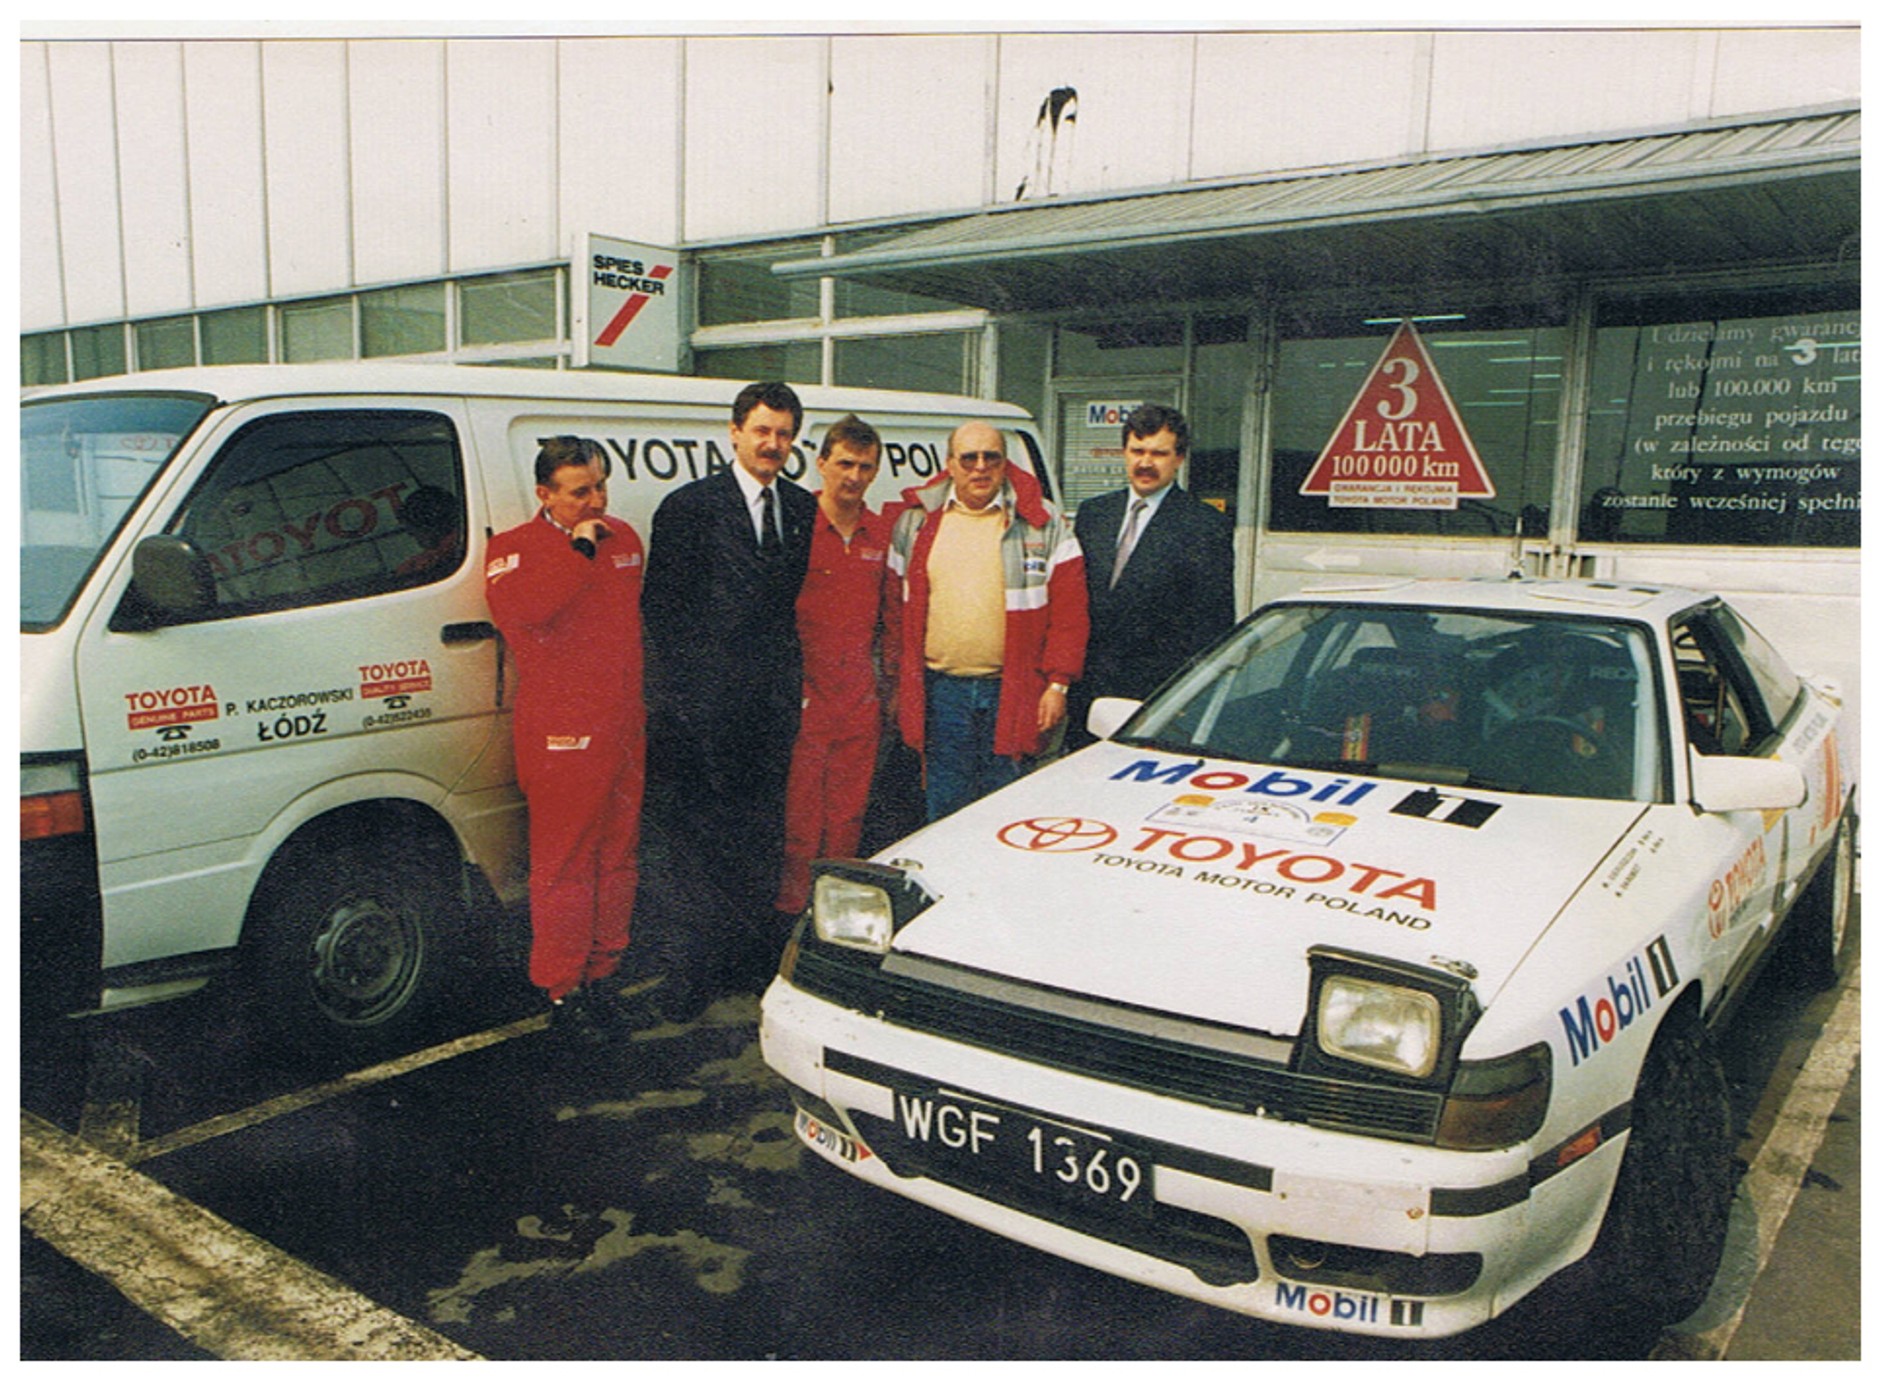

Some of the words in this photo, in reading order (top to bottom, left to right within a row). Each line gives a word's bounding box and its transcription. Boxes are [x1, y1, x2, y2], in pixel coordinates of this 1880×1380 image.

[593, 254, 645, 276] SPIES
[593, 271, 665, 296] HECKER
[1769, 322, 1861, 344] gwaranc
[1755, 354, 1779, 368] na
[1791, 338, 1817, 366] 3
[1376, 357, 1420, 420] 3
[1668, 380, 1701, 399] lub
[1714, 378, 1791, 397] 100.000
[1803, 377, 1838, 393] km
[1088, 404, 1142, 424] Mob
[1654, 408, 1753, 431] przebiegu
[1765, 404, 1848, 428] pojazdu
[1353, 420, 1446, 452] LATA
[1634, 437, 1660, 455] (w
[1669, 435, 1771, 452] zależności
[1782, 433, 1809, 451] od
[1422, 455, 1460, 478] km
[1651, 463, 1703, 484] który
[1712, 468, 1725, 480] z
[1736, 464, 1840, 485] wymogów
[1601, 492, 1679, 508] zostanie
[1689, 492, 1787, 514] wcześniej
[358, 659, 431, 682] TOYOTA
[124, 684, 217, 711] TOYOTA
[225, 702, 239, 717] P.
[246, 688, 354, 713] KACZOROWSKI
[258, 707, 327, 741] ŁÓDŹ
[1110, 760, 1378, 806] Mobil
[1133, 827, 1438, 911] TOYOTA
[1093, 853, 1185, 879] TOYOTA
[1194, 871, 1297, 899] MOTOR
[1305, 892, 1433, 932] POLAND
[1559, 956, 1651, 1067] Mobil
[900, 1095, 1000, 1153] WGF
[1027, 1127, 1141, 1202] 1369
[1276, 1282, 1379, 1324] Mobil
